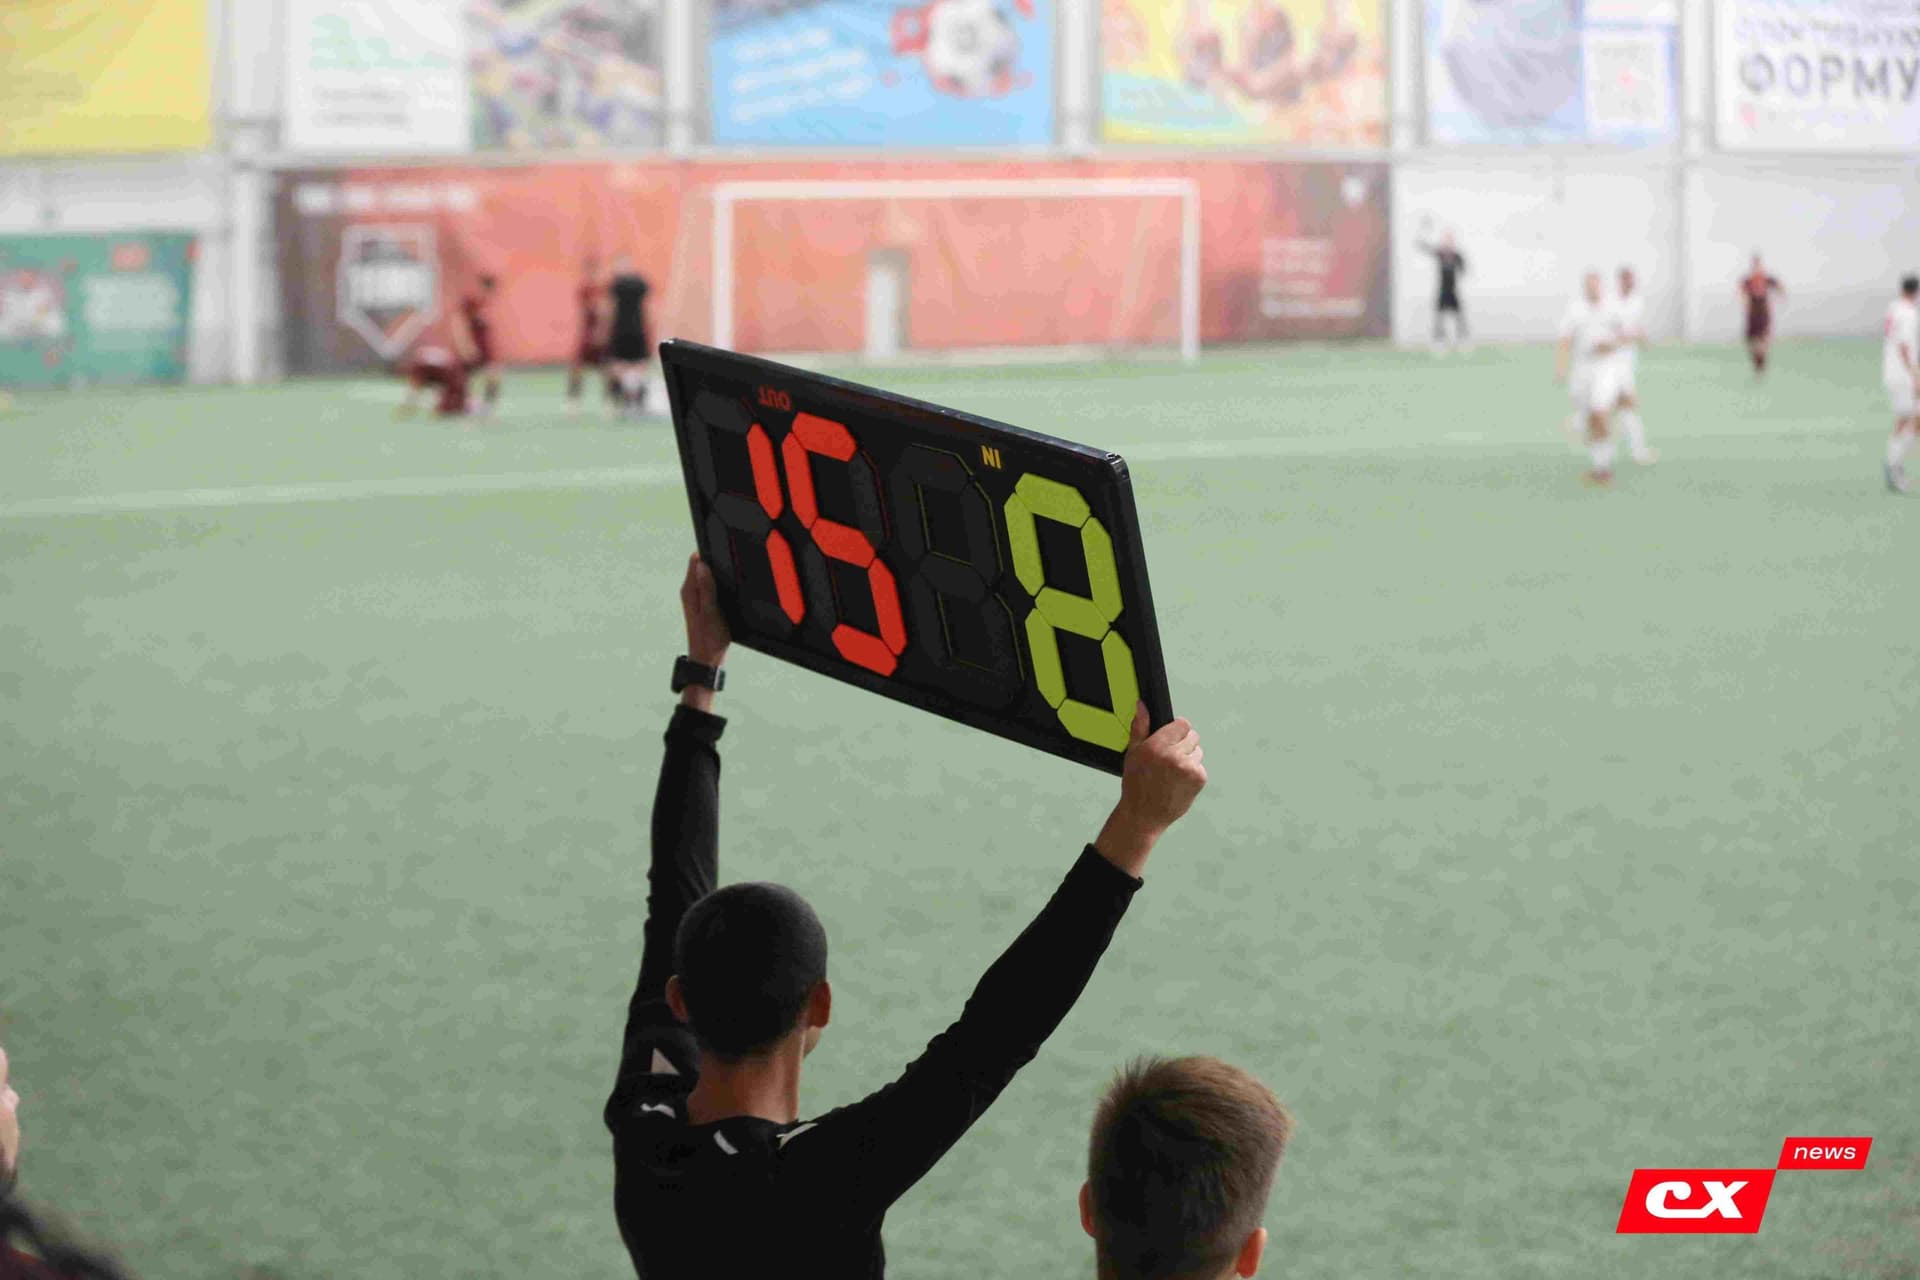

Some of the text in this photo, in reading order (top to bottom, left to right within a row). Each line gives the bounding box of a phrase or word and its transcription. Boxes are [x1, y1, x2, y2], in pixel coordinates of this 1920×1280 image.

[759, 386, 791, 411] OUT
[981, 445, 1001, 469] IN
[748, 412, 907, 676] 15
[1004, 473, 1141, 752] 8
